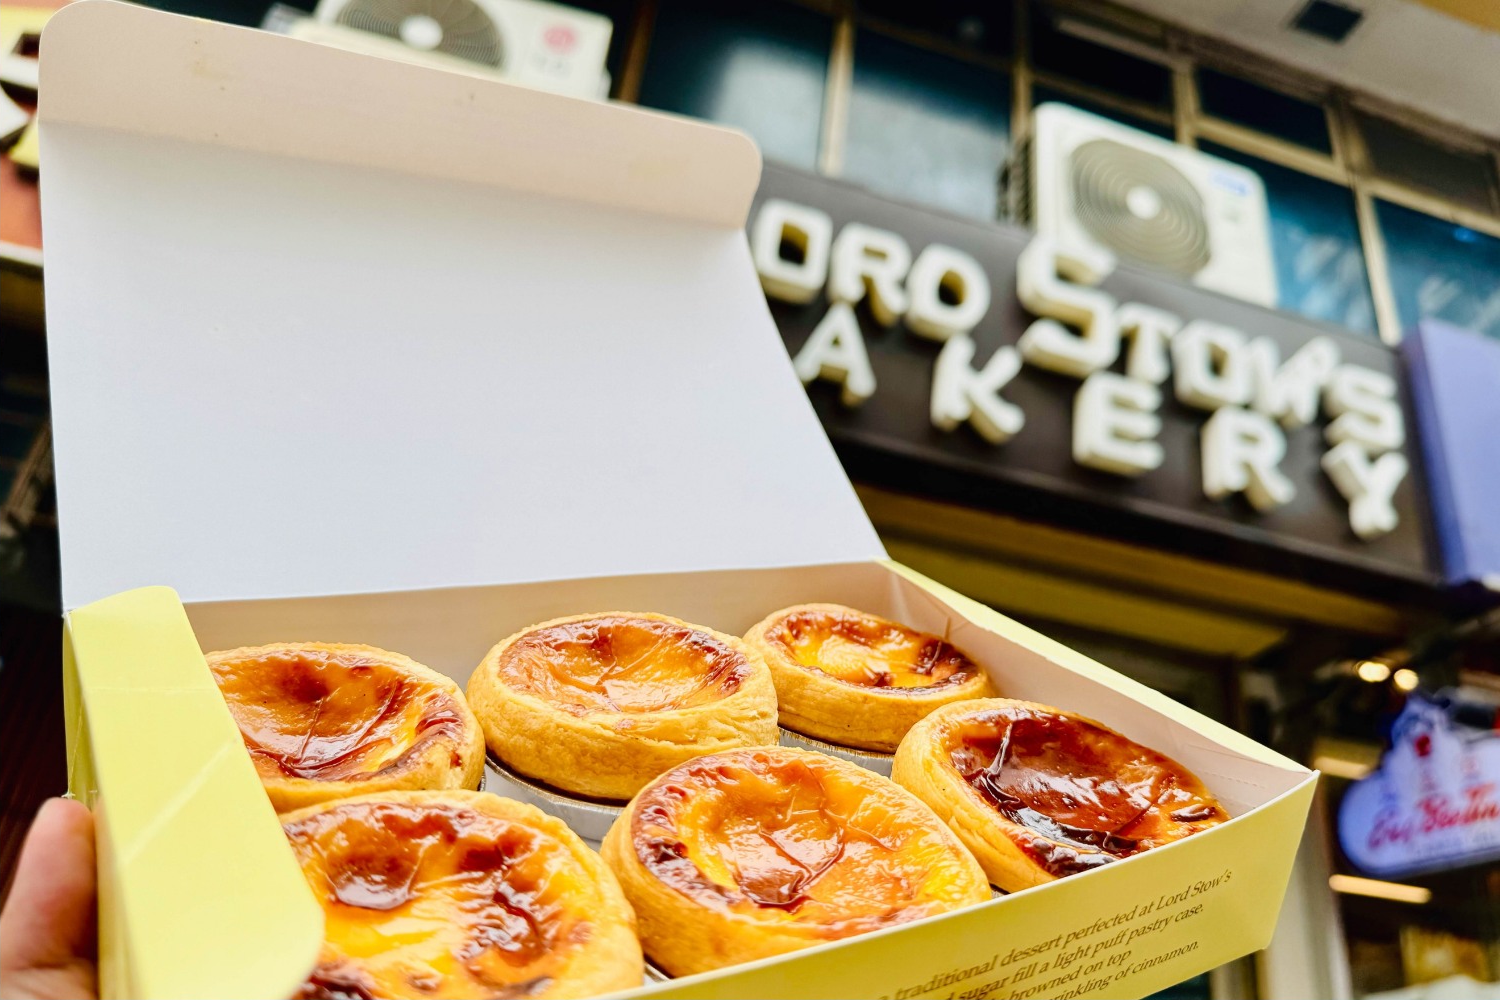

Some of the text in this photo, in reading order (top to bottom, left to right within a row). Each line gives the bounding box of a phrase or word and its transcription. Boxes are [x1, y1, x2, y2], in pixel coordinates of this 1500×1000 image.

[895, 869, 1232, 1000] traditional dessert perfected at Lord Stow's
[1011, 962, 1039, 984] fill
[1038, 961, 1050, 974] a
[1052, 945, 1093, 969] light
[1091, 928, 1130, 958] puff
[1125, 914, 1172, 945] pastry
[1173, 904, 1204, 925] case.
[1114, 966, 1131, 981] of
[1132, 940, 1199, 974] cinnamon.
[1008, 950, 1132, 1000] browned on top
